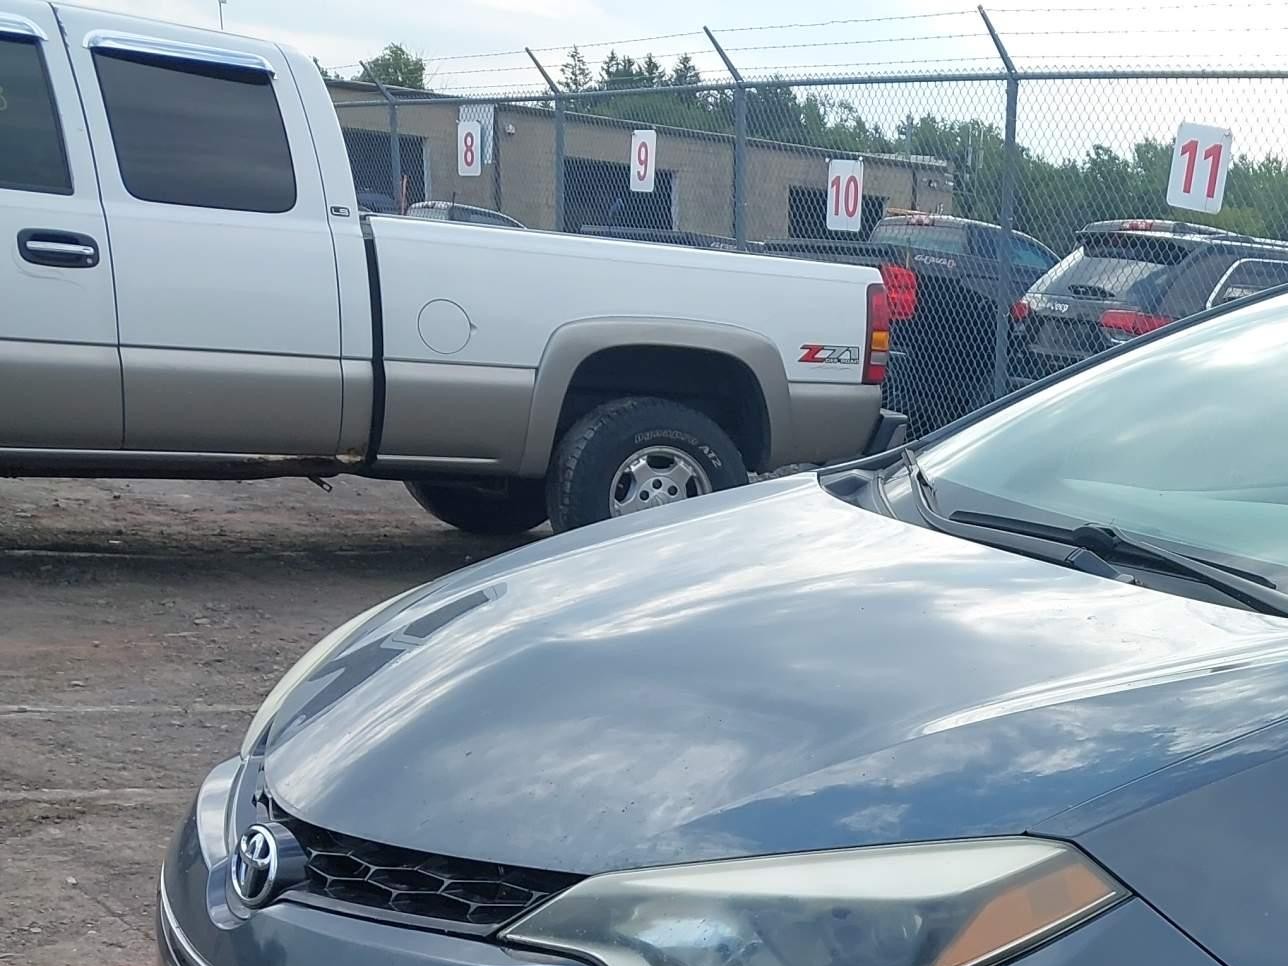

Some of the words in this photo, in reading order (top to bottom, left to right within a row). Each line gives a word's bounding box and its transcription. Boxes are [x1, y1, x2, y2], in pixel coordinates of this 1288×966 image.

[464, 131, 475, 167] 8
[636, 141, 650, 182] 9
[1180, 139, 1222, 198] 11
[831, 174, 859, 218] 10
[798, 344, 860, 363] Z71
